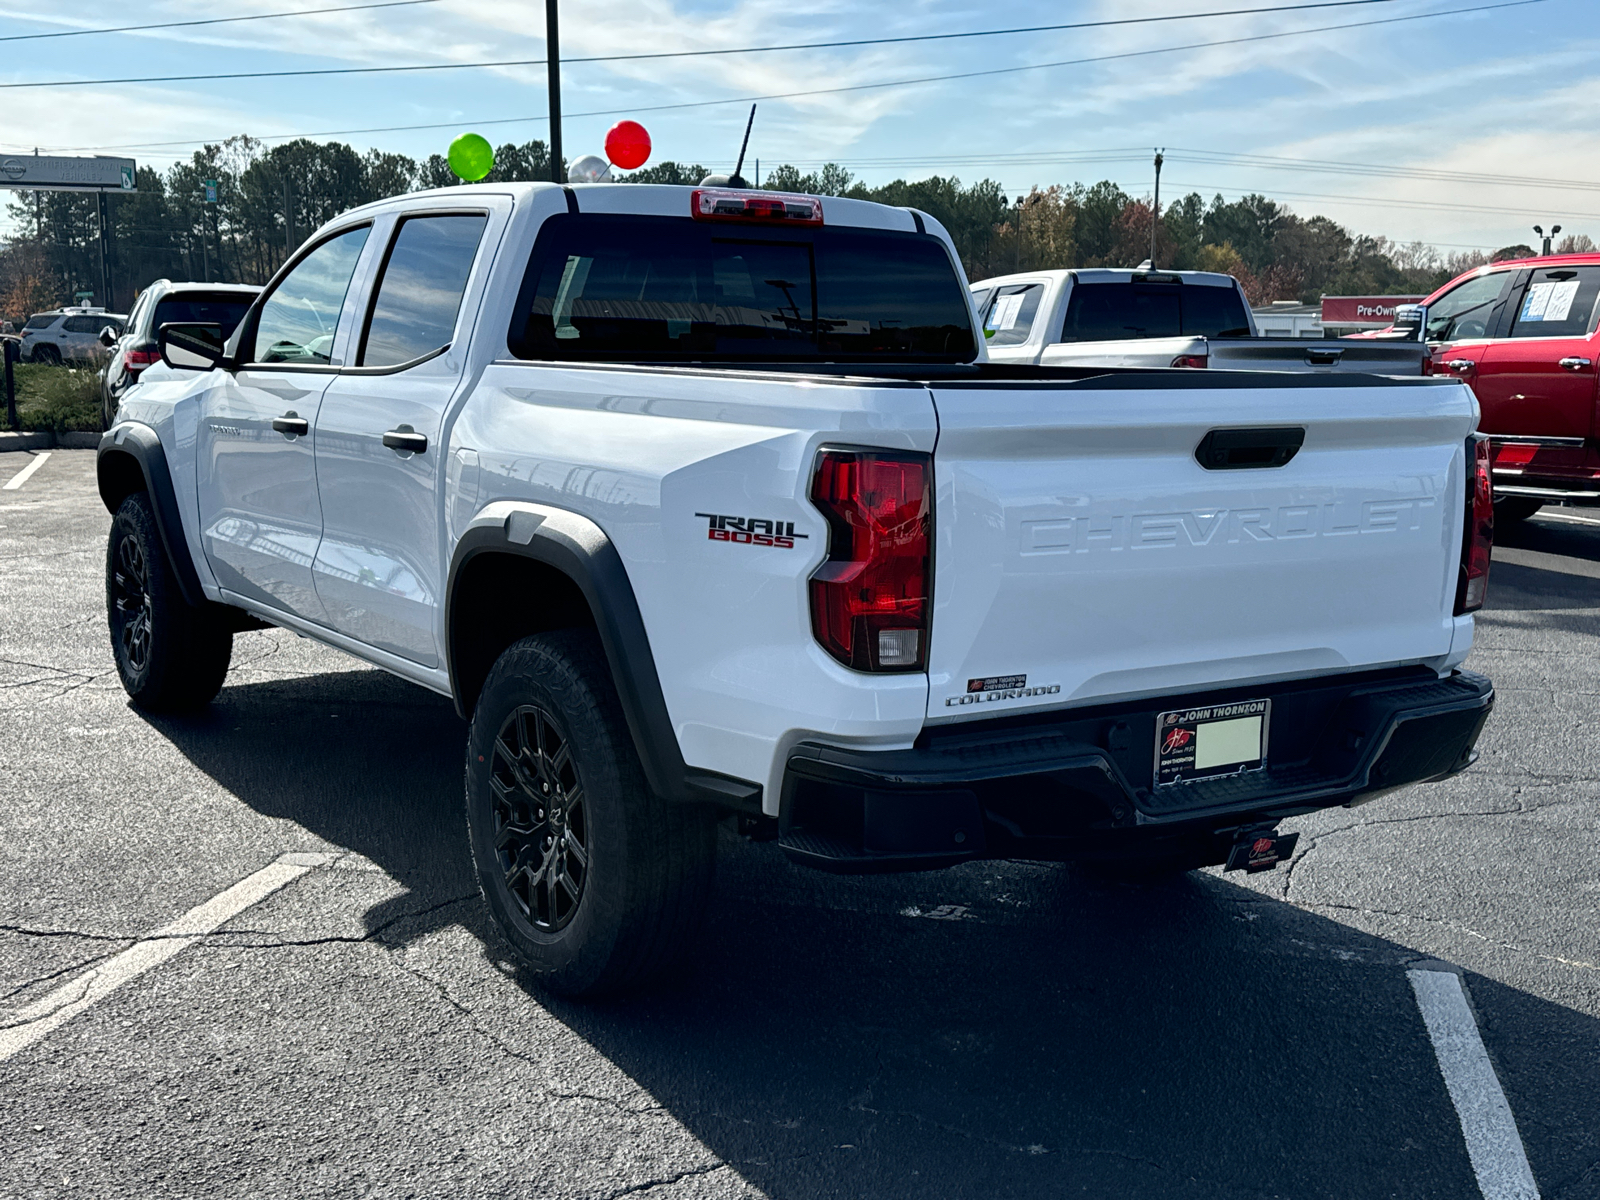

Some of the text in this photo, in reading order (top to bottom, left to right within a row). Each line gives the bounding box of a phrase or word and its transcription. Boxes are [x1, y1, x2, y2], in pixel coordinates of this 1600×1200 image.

[28, 160, 75, 168] CERTIFIED
[60, 171, 103, 182] VEHICLES
[124, 178, 129, 186] 6
[694, 512, 809, 539] TRAIL
[1020, 496, 1437, 557] CHEVROLET
[708, 529, 794, 548] BOSS
[998, 676, 1025, 684] THORNTON
[945, 684, 1061, 706] COLORADO
[1184, 702, 1265, 721] JOHN THORNTON
